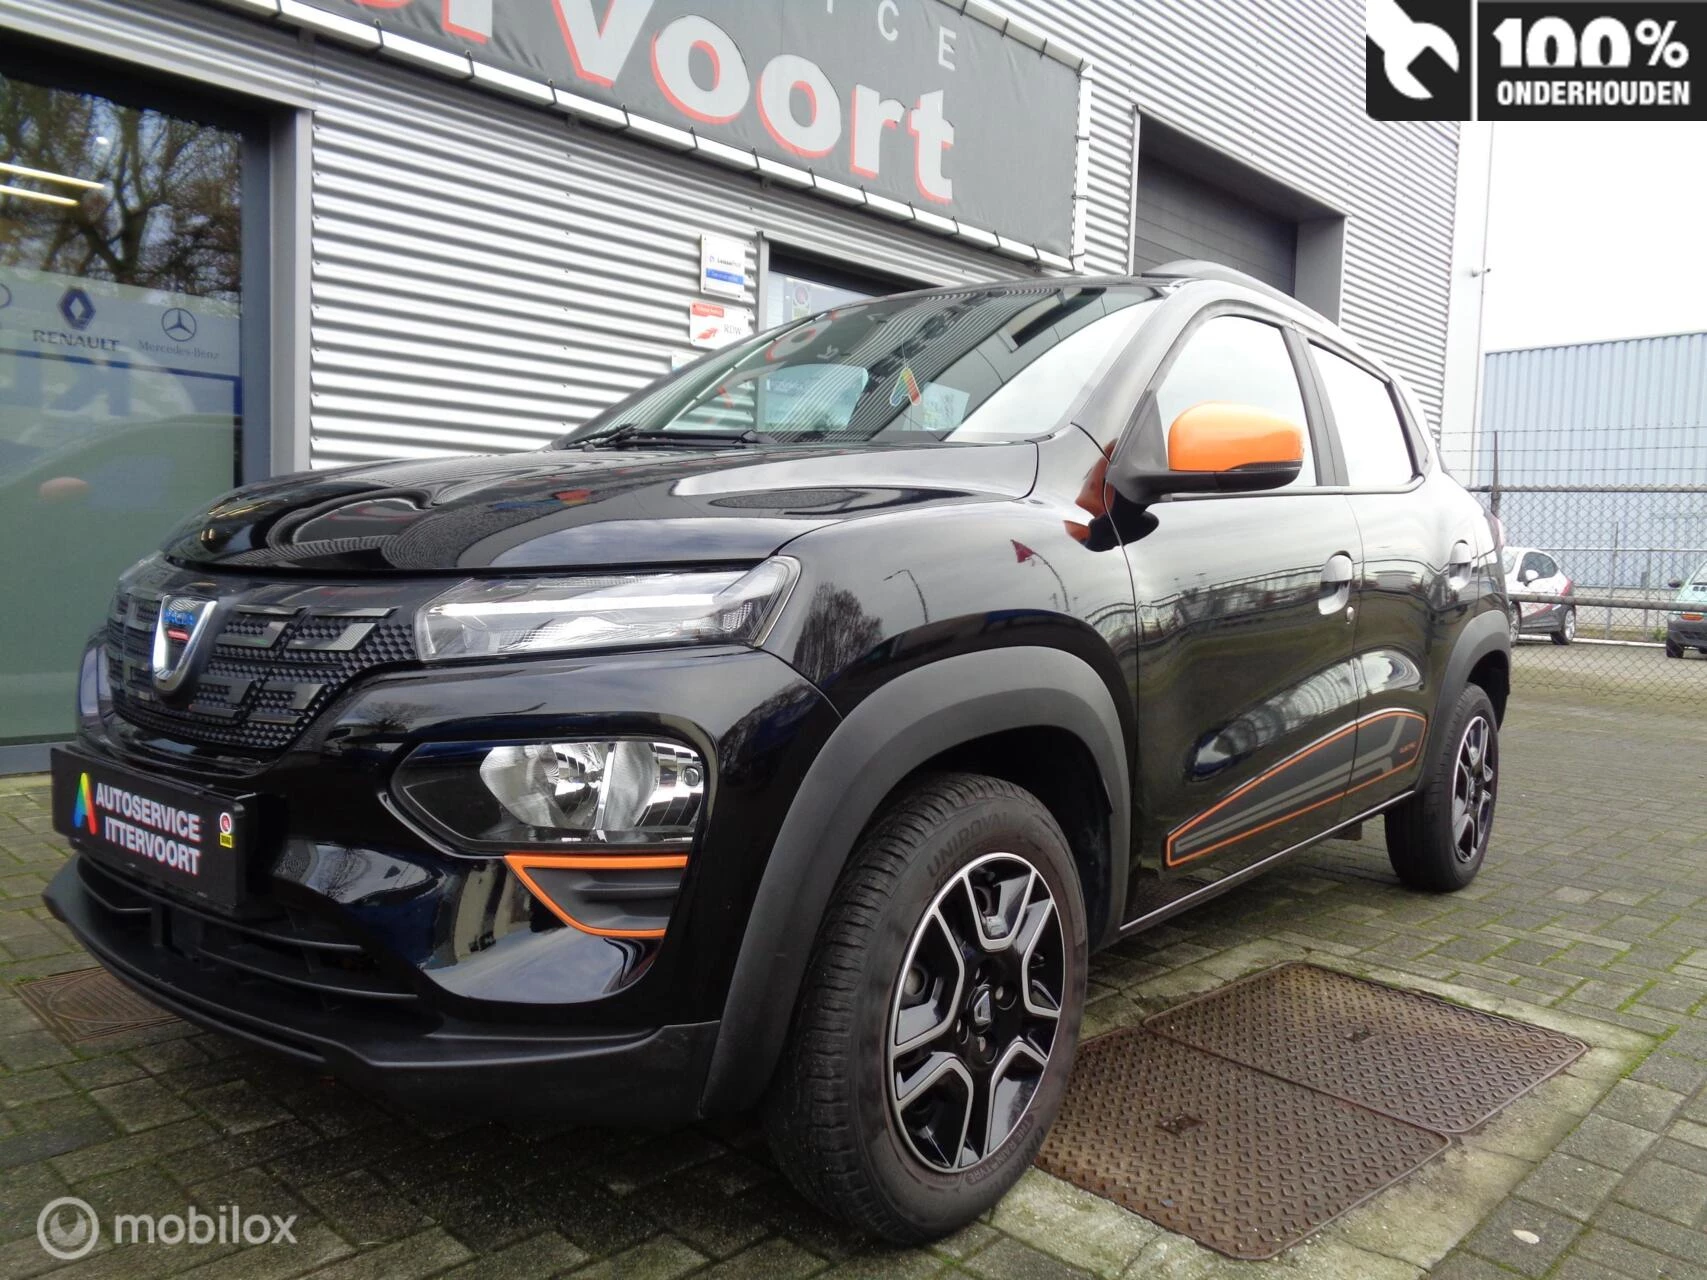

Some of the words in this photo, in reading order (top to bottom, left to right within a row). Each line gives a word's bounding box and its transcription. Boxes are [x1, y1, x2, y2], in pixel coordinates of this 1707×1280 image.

[32, 329, 120, 352] RENAULT
[138, 338, 220, 361] Mercedes-Benz
[95, 782, 201, 842] AUTOSERVICE
[104, 816, 201, 876] ITTERVOORT
[926, 811, 1009, 878] UNIROYAL
